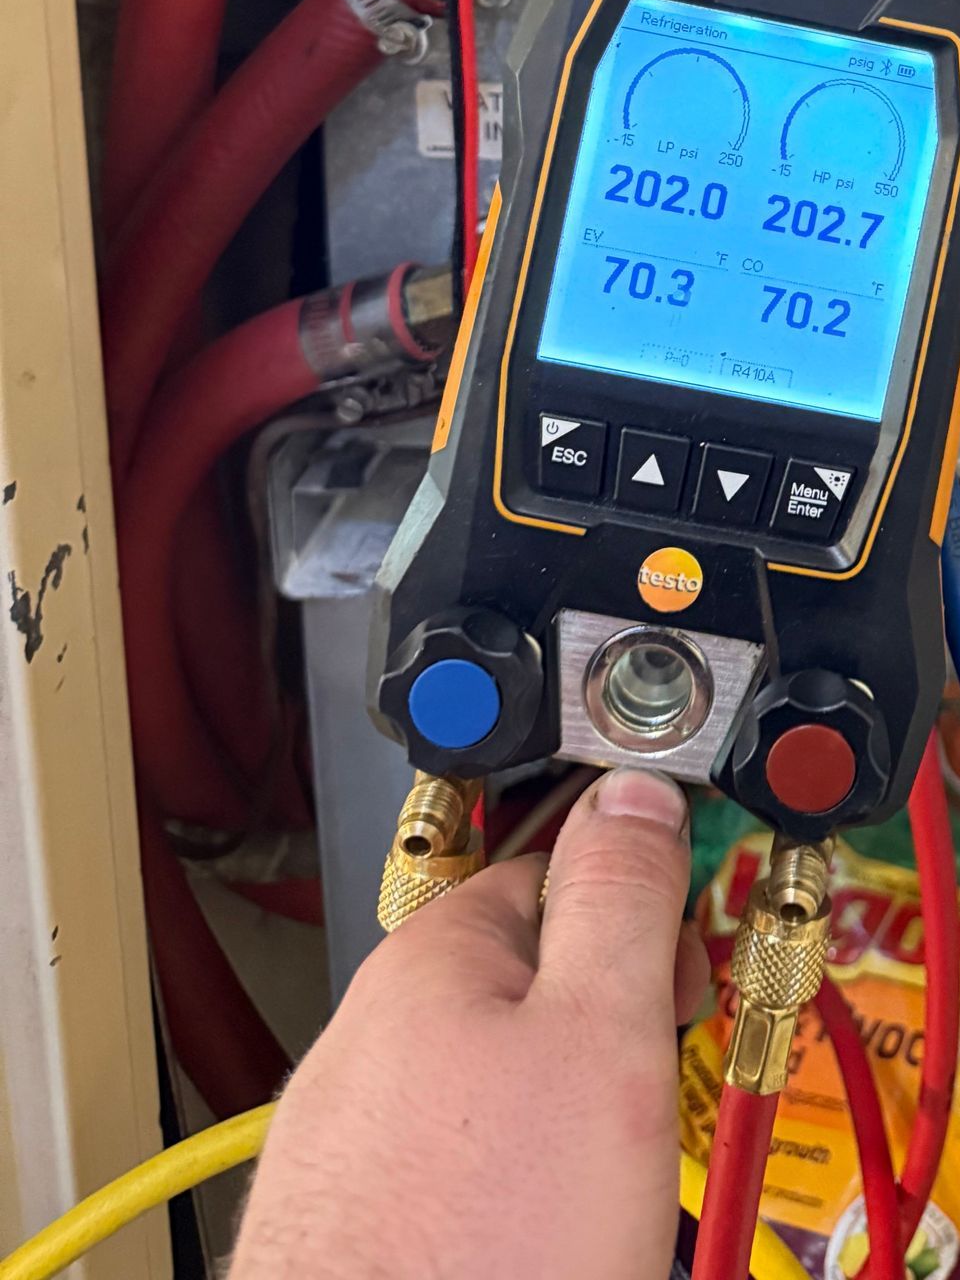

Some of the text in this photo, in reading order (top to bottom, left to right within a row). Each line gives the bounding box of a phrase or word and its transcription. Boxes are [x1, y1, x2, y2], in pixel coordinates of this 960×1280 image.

[641, 11, 728, 41] Refrigeration
[849, 55, 875, 72] psig
[657, 141, 699, 161] LP psi
[718, 152, 744, 168] 250
[771, 164, 792, 177] -15
[812, 170, 855, 190] HP psi
[604, 163, 728, 221] 202.0
[874, 182, 899, 198] 550
[762, 194, 885, 249] 202.7
[584, 228, 604, 243] EV
[742, 258, 764, 273] CO
[602, 256, 695, 307] 70.3
[760, 285, 852, 338] 70.2
[731, 363, 776, 384] R410A
[551, 446, 588, 466] ESC
[790, 482, 829, 501] Menu
[787, 500, 824, 519] Enter
[638, 566, 701, 593] testo
